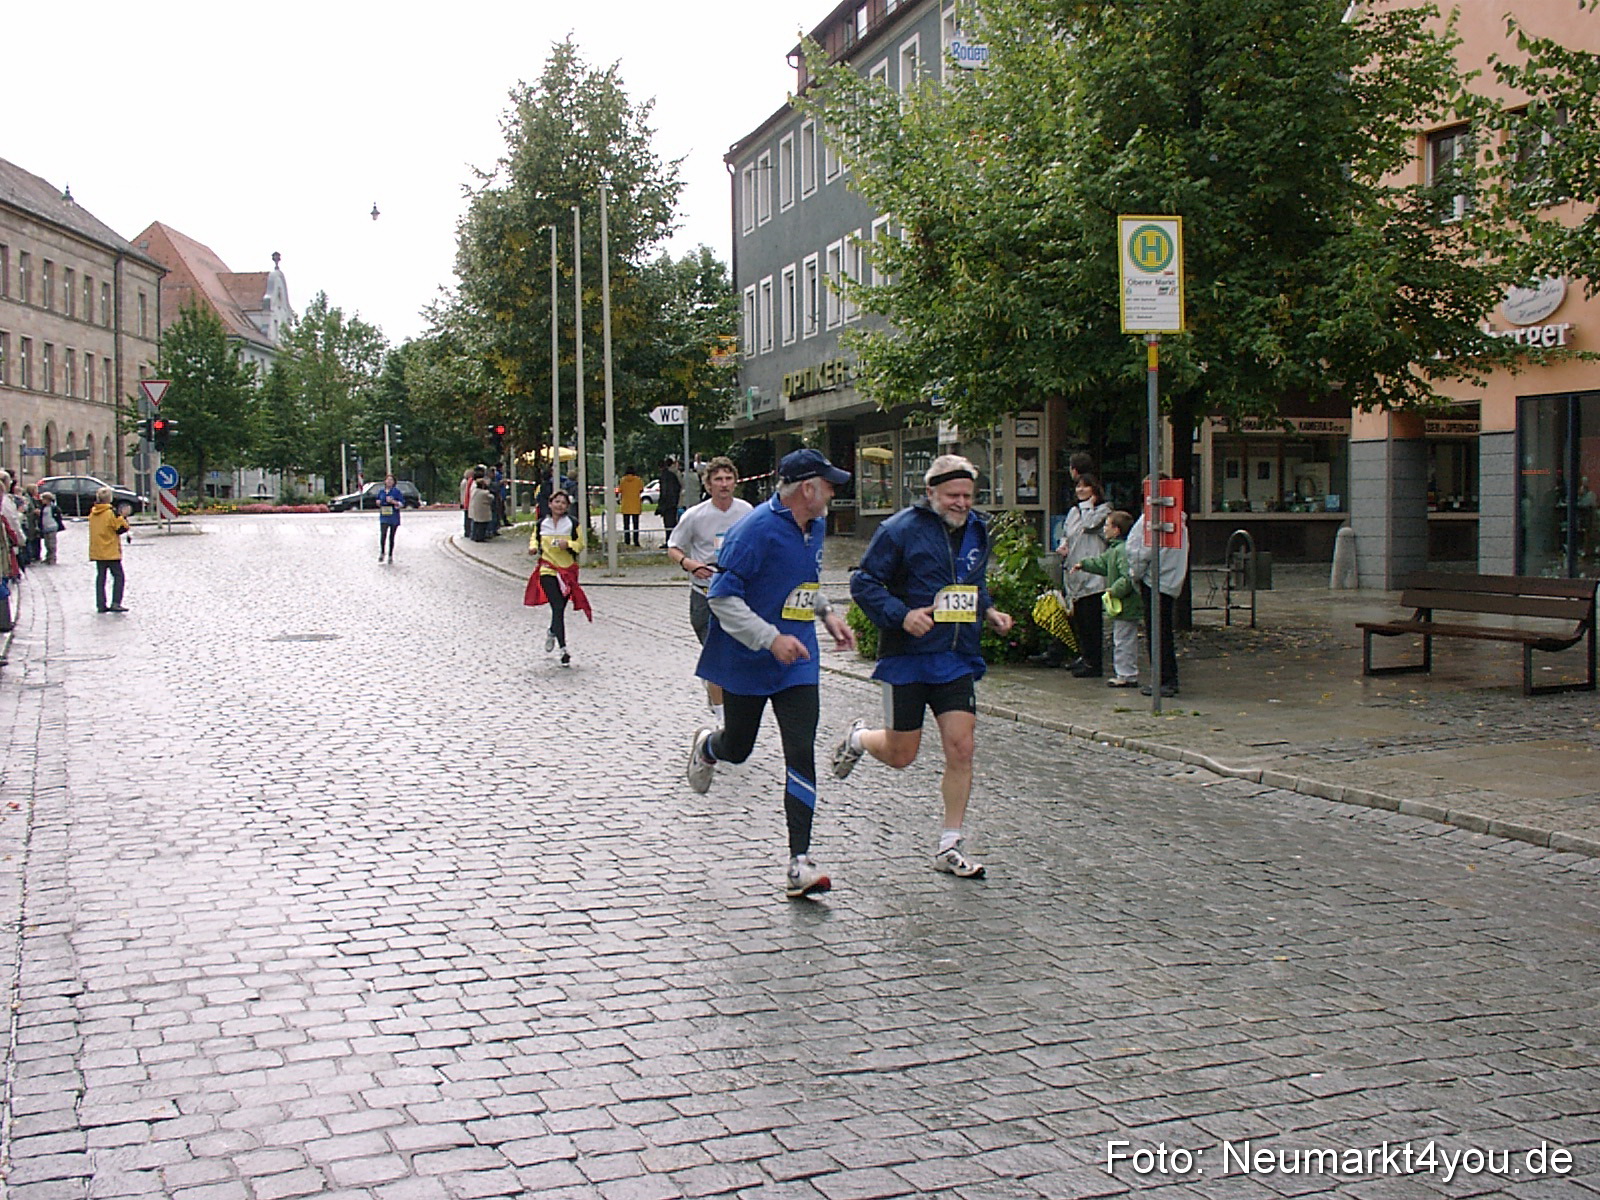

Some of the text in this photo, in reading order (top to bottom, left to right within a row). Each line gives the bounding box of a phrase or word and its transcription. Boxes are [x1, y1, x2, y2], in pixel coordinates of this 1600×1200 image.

[1141, 235, 1163, 262] H
[782, 357, 844, 397] OPTIKER
[660, 408, 680, 422] WC
[943, 594, 974, 610] 1334
